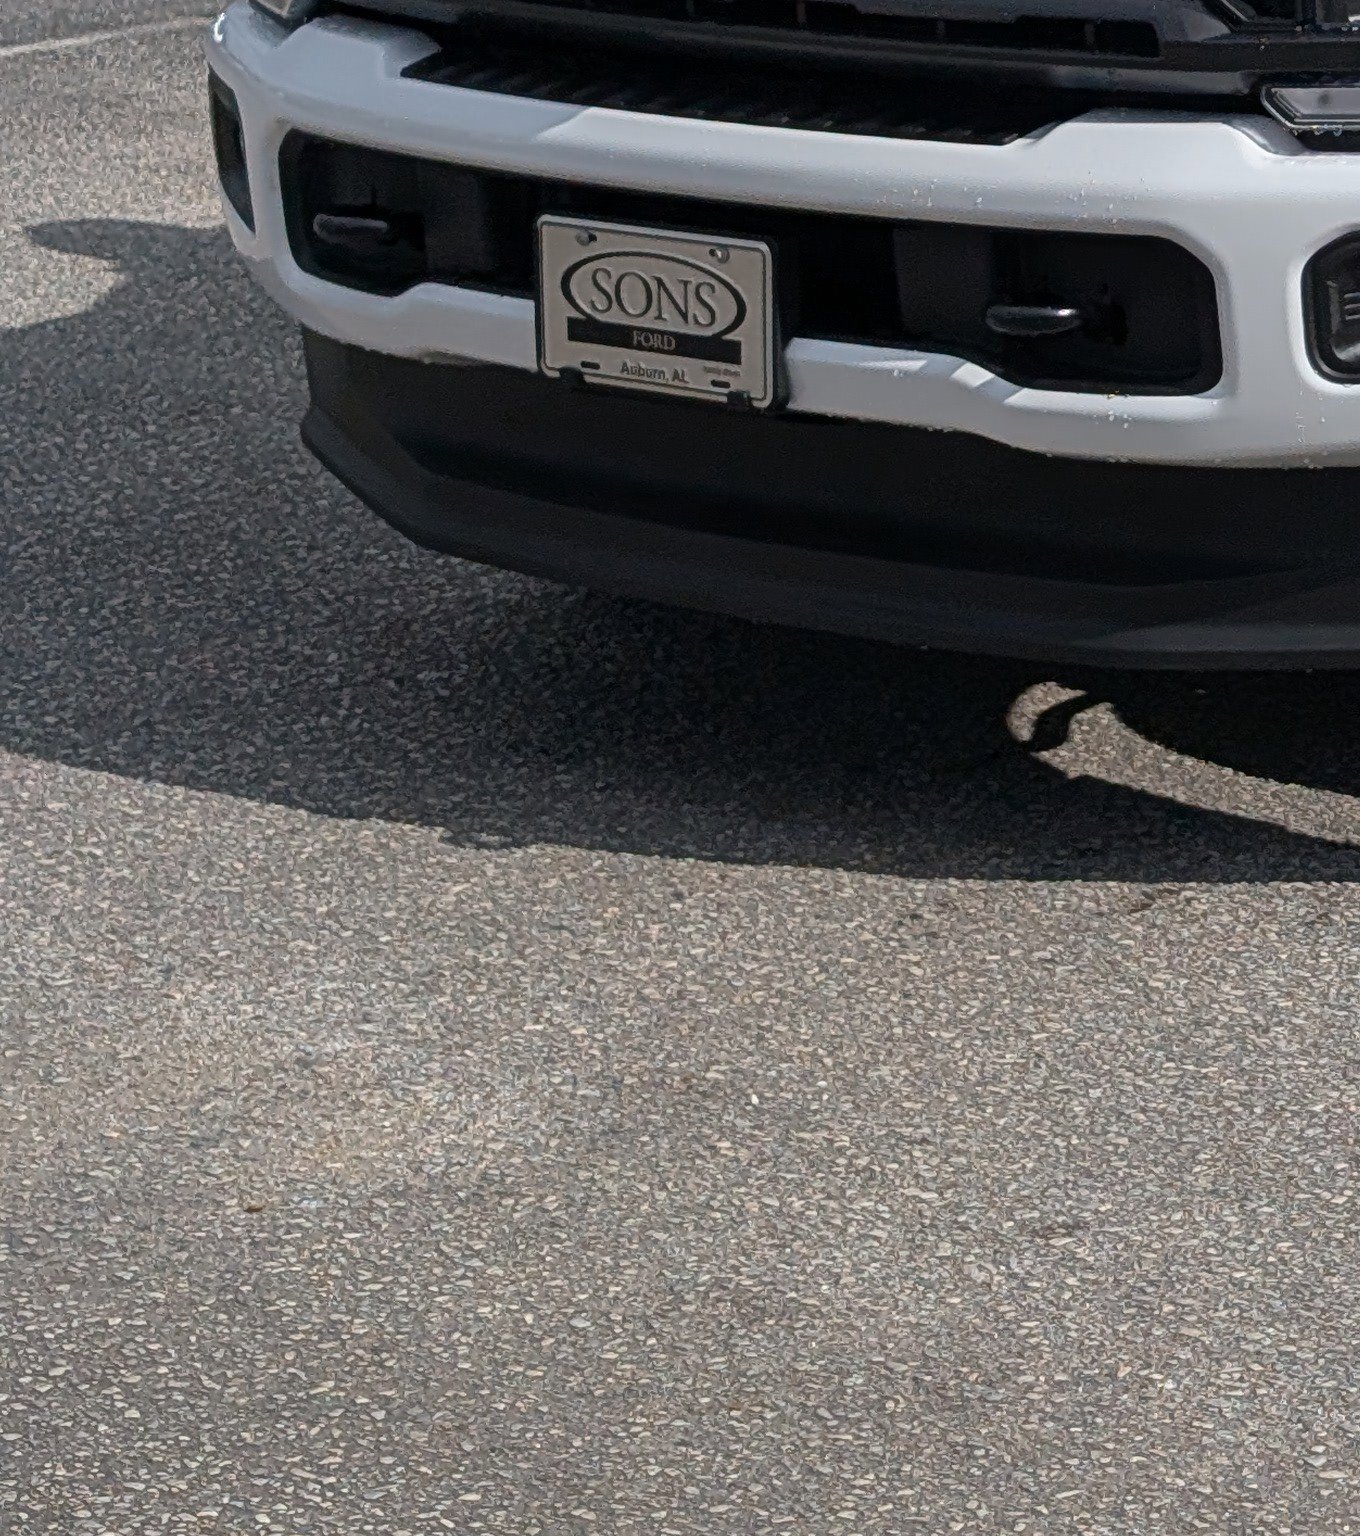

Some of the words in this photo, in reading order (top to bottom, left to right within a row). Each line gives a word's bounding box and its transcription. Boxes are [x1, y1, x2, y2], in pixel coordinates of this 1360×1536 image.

[589, 266, 717, 328] SONS
[632, 329, 677, 351] FORD
[619, 361, 670, 383] Auburn,
[672, 368, 691, 384] AL
